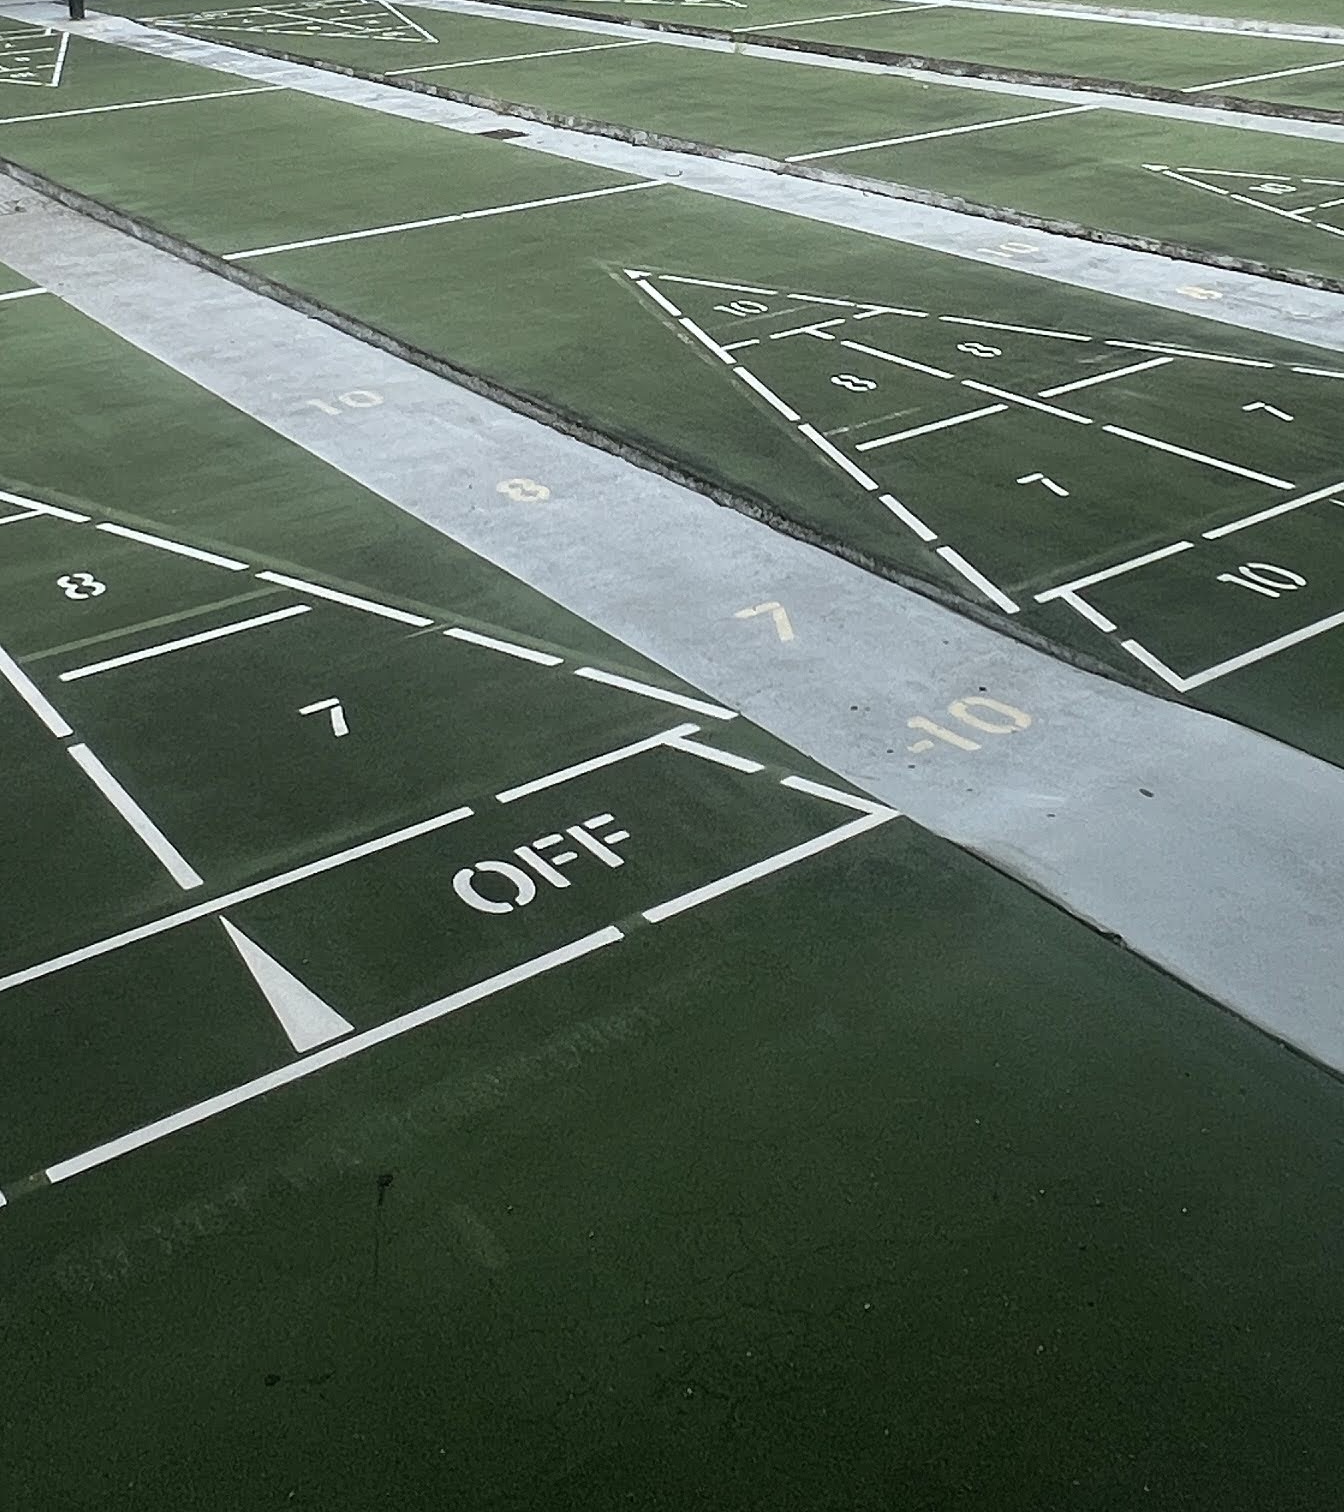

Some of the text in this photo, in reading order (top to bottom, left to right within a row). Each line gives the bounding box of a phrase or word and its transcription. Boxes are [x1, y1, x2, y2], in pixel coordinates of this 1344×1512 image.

[713, 300, 768, 316] 10
[958, 342, 1001, 358] 8
[830, 374, 877, 392] 8
[306, 390, 384, 415] 10
[1242, 402, 1294, 421] 7
[496, 478, 551, 502] 8
[1016, 472, 1070, 497] 7
[57, 572, 106, 600] 8
[1216, 561, 1306, 598] 10
[734, 601, 796, 642] 7
[298, 698, 349, 737] 7
[453, 813, 630, 914] OFF
